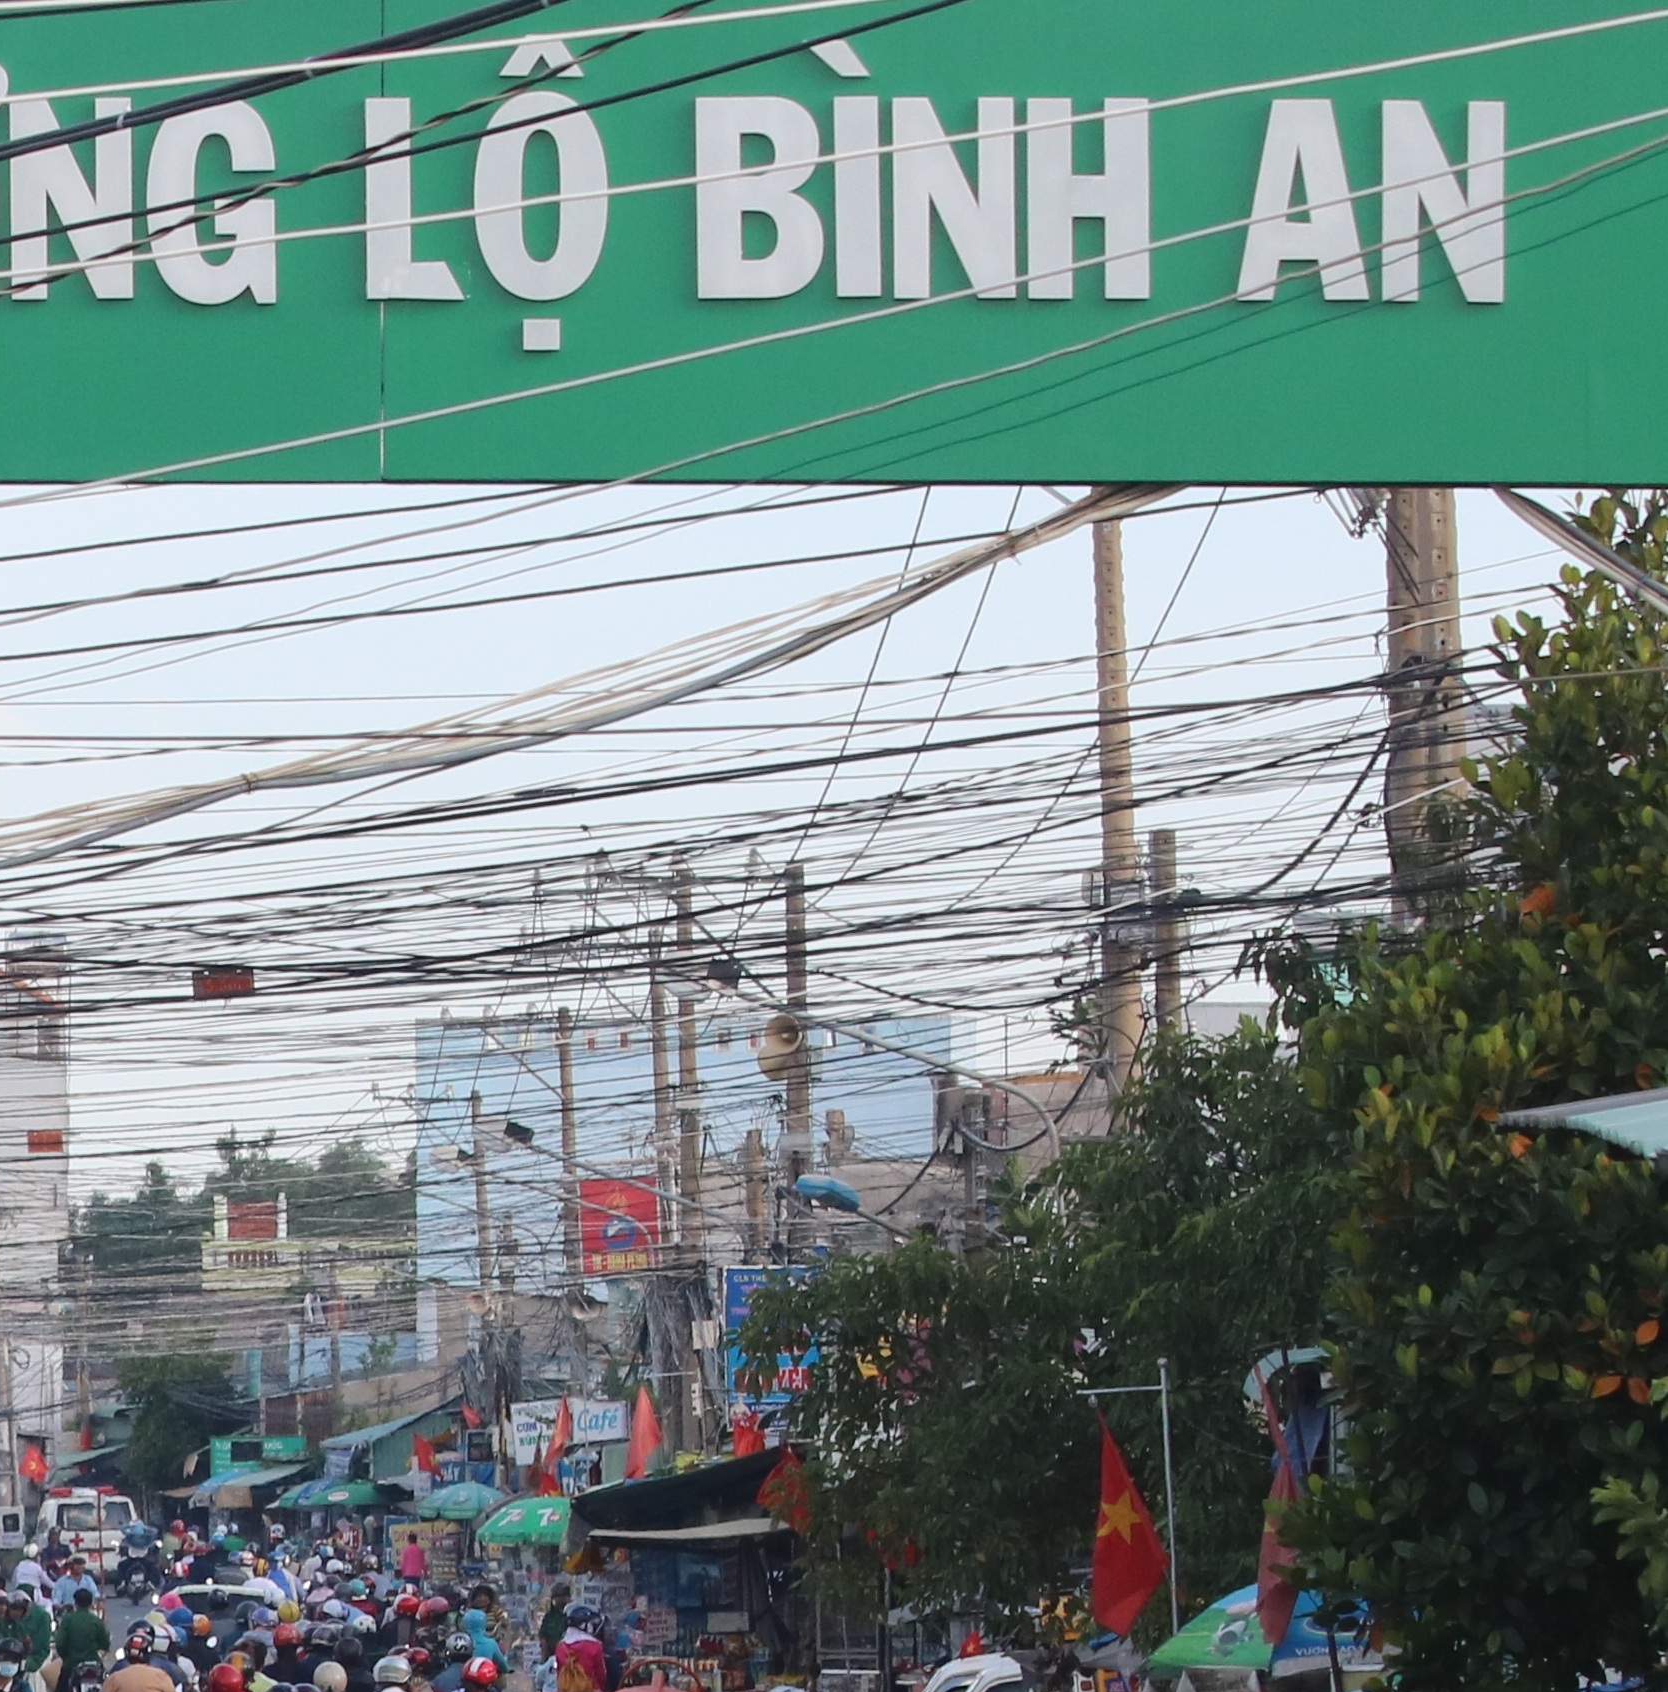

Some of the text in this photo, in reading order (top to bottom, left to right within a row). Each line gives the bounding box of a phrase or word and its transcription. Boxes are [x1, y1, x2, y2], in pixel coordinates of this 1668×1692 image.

[366, 39, 612, 351] LỘ
[697, 38, 1153, 301] BÌNH
[1235, 97, 1506, 304] AN
[577, 1408, 619, 1434] Café
